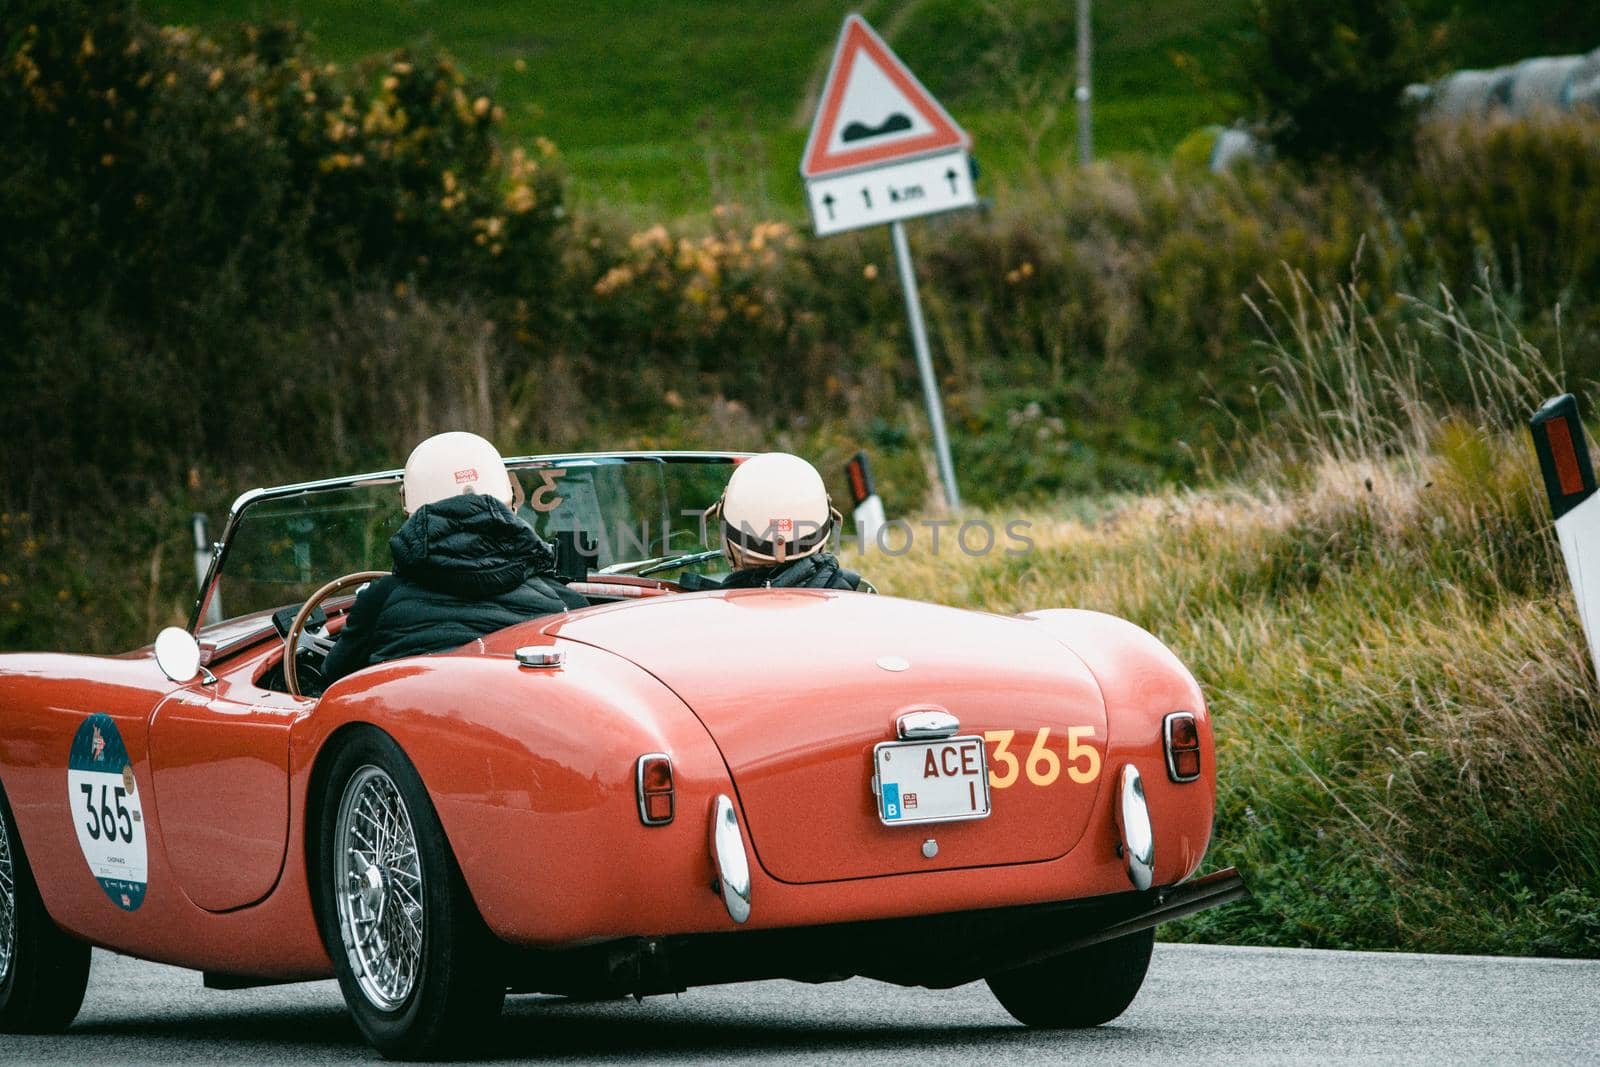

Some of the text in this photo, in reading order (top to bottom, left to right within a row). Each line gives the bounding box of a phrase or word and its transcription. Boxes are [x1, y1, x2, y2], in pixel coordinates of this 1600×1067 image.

[861, 185, 925, 208] 1 km
[924, 745, 979, 778] ACE
[984, 726, 1101, 789] 365
[80, 783, 133, 844] 365
[887, 804, 897, 816] B
